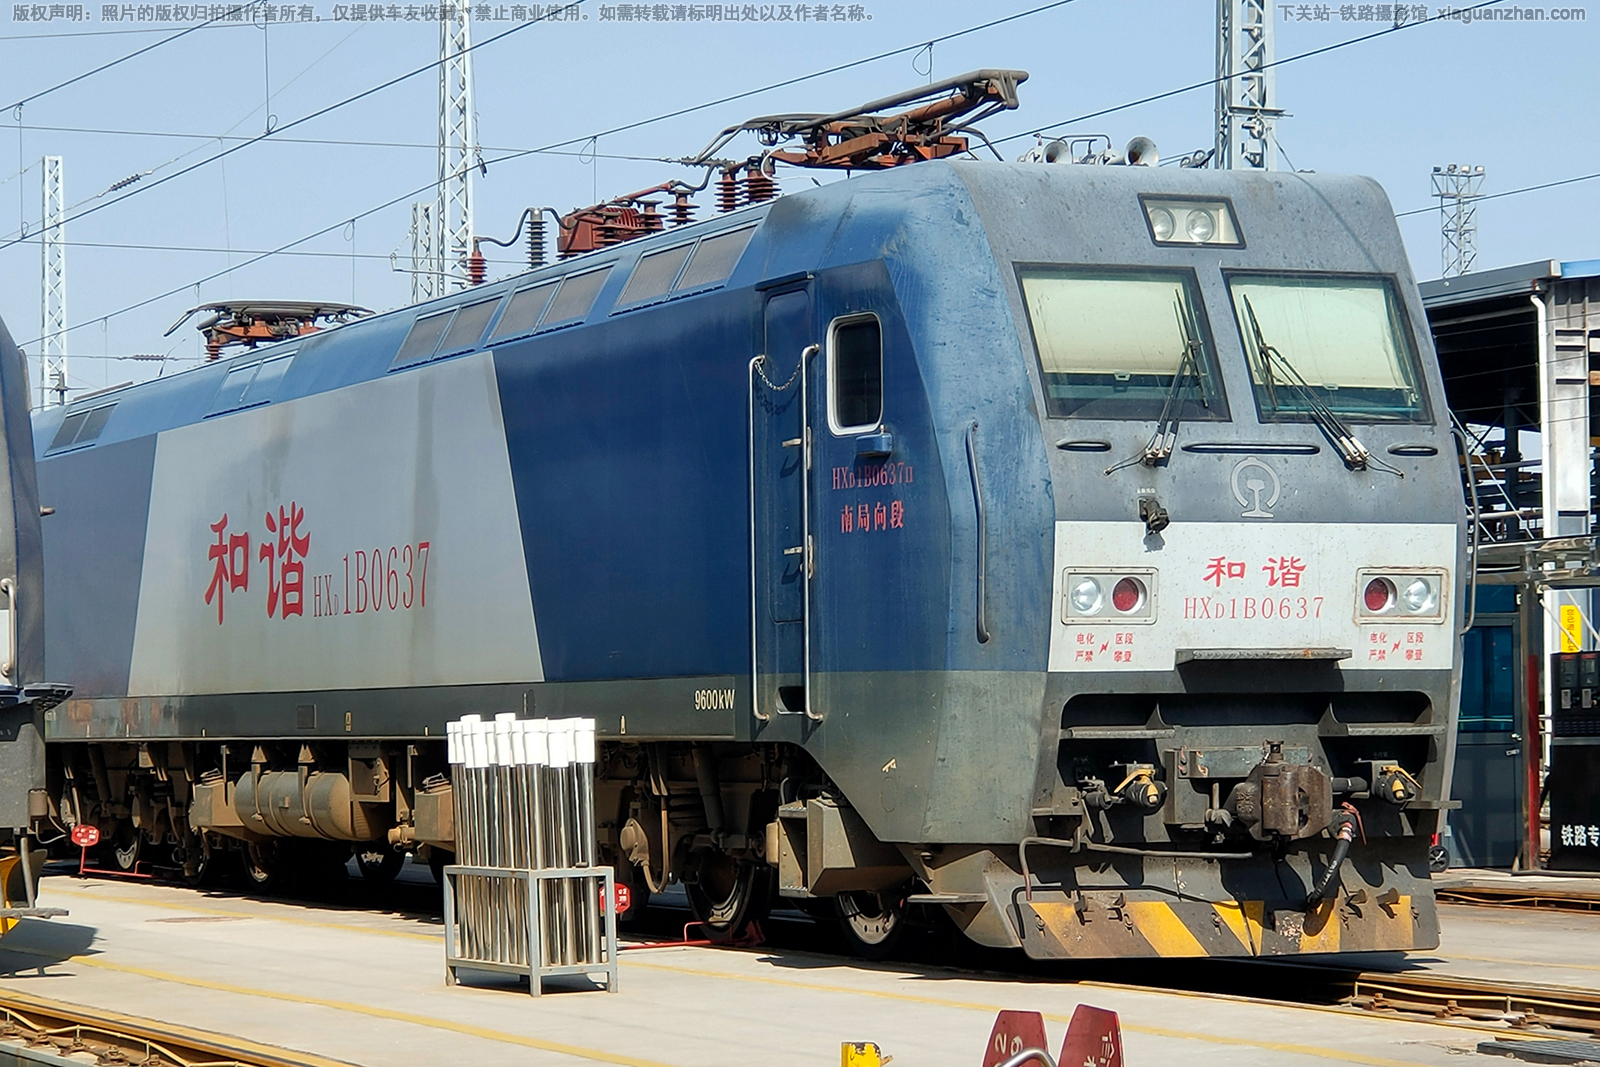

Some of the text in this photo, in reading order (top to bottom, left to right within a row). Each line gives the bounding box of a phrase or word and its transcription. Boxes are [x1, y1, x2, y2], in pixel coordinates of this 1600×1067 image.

[204, 501, 310, 625] 和谐
[1203, 556, 1306, 587] 和谐
[1184, 597, 1324, 619] HXD1B0637
[694, 689, 735, 710] 9600kW
[1561, 824, 1600, 847] 铁路专
